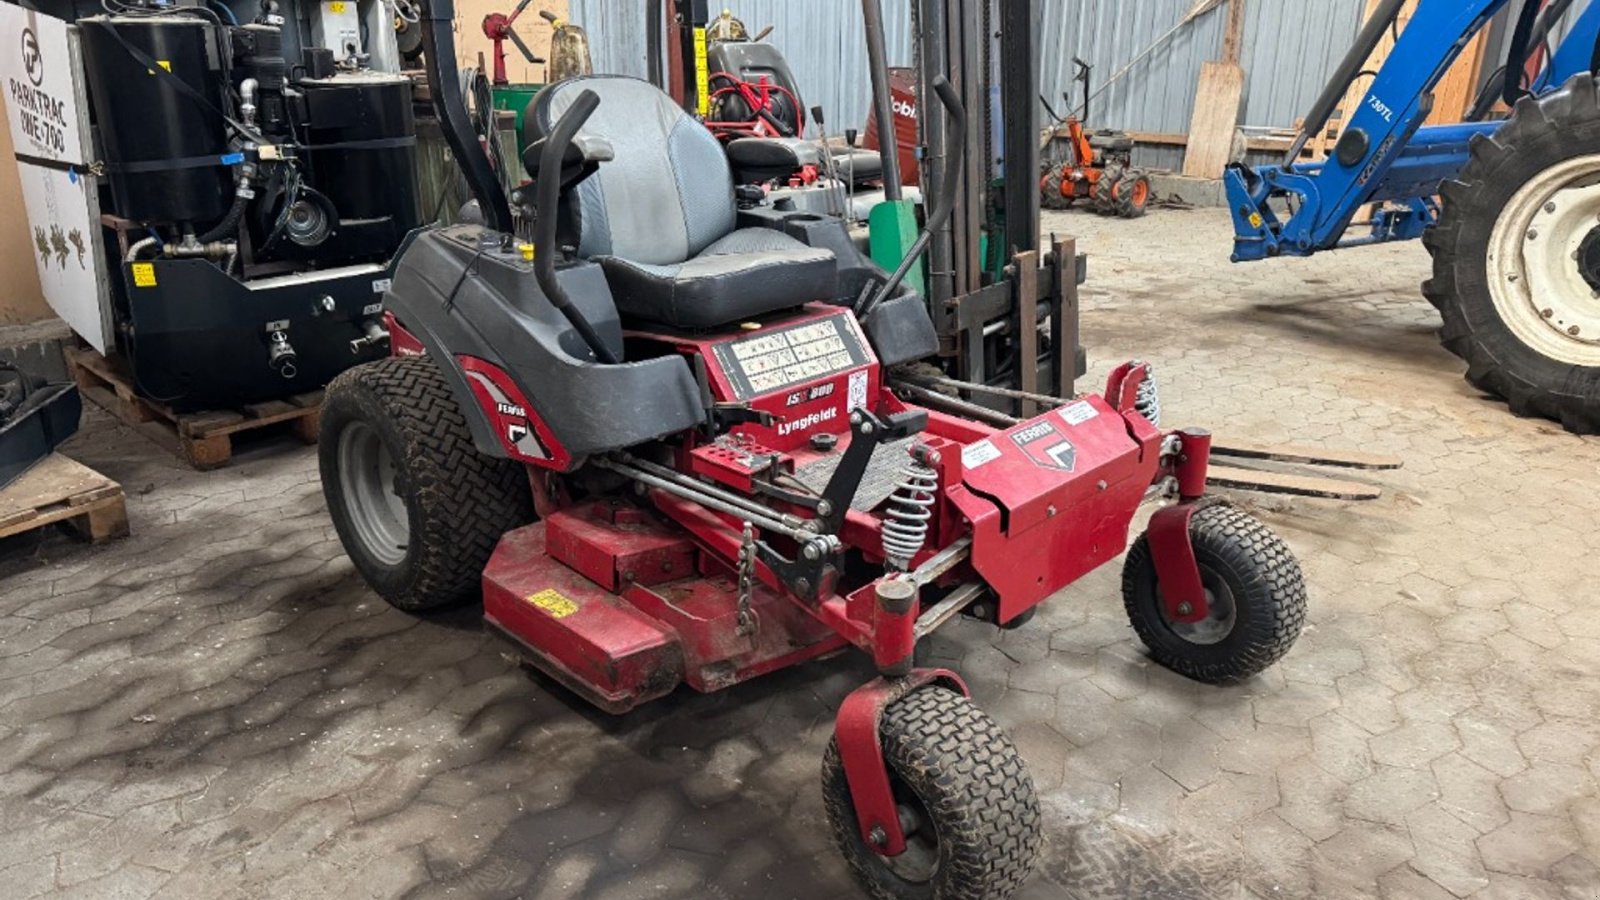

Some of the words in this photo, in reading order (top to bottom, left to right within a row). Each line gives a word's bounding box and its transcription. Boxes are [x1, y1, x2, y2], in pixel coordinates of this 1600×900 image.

[10, 77, 67, 128] PARKTRAC
[1367, 94, 1393, 122] 730TL
[810, 382, 835, 400] 800
[498, 402, 526, 417] FERRIS
[778, 406, 838, 435] Lyngfeldt
[1011, 420, 1054, 445] FERRIS
